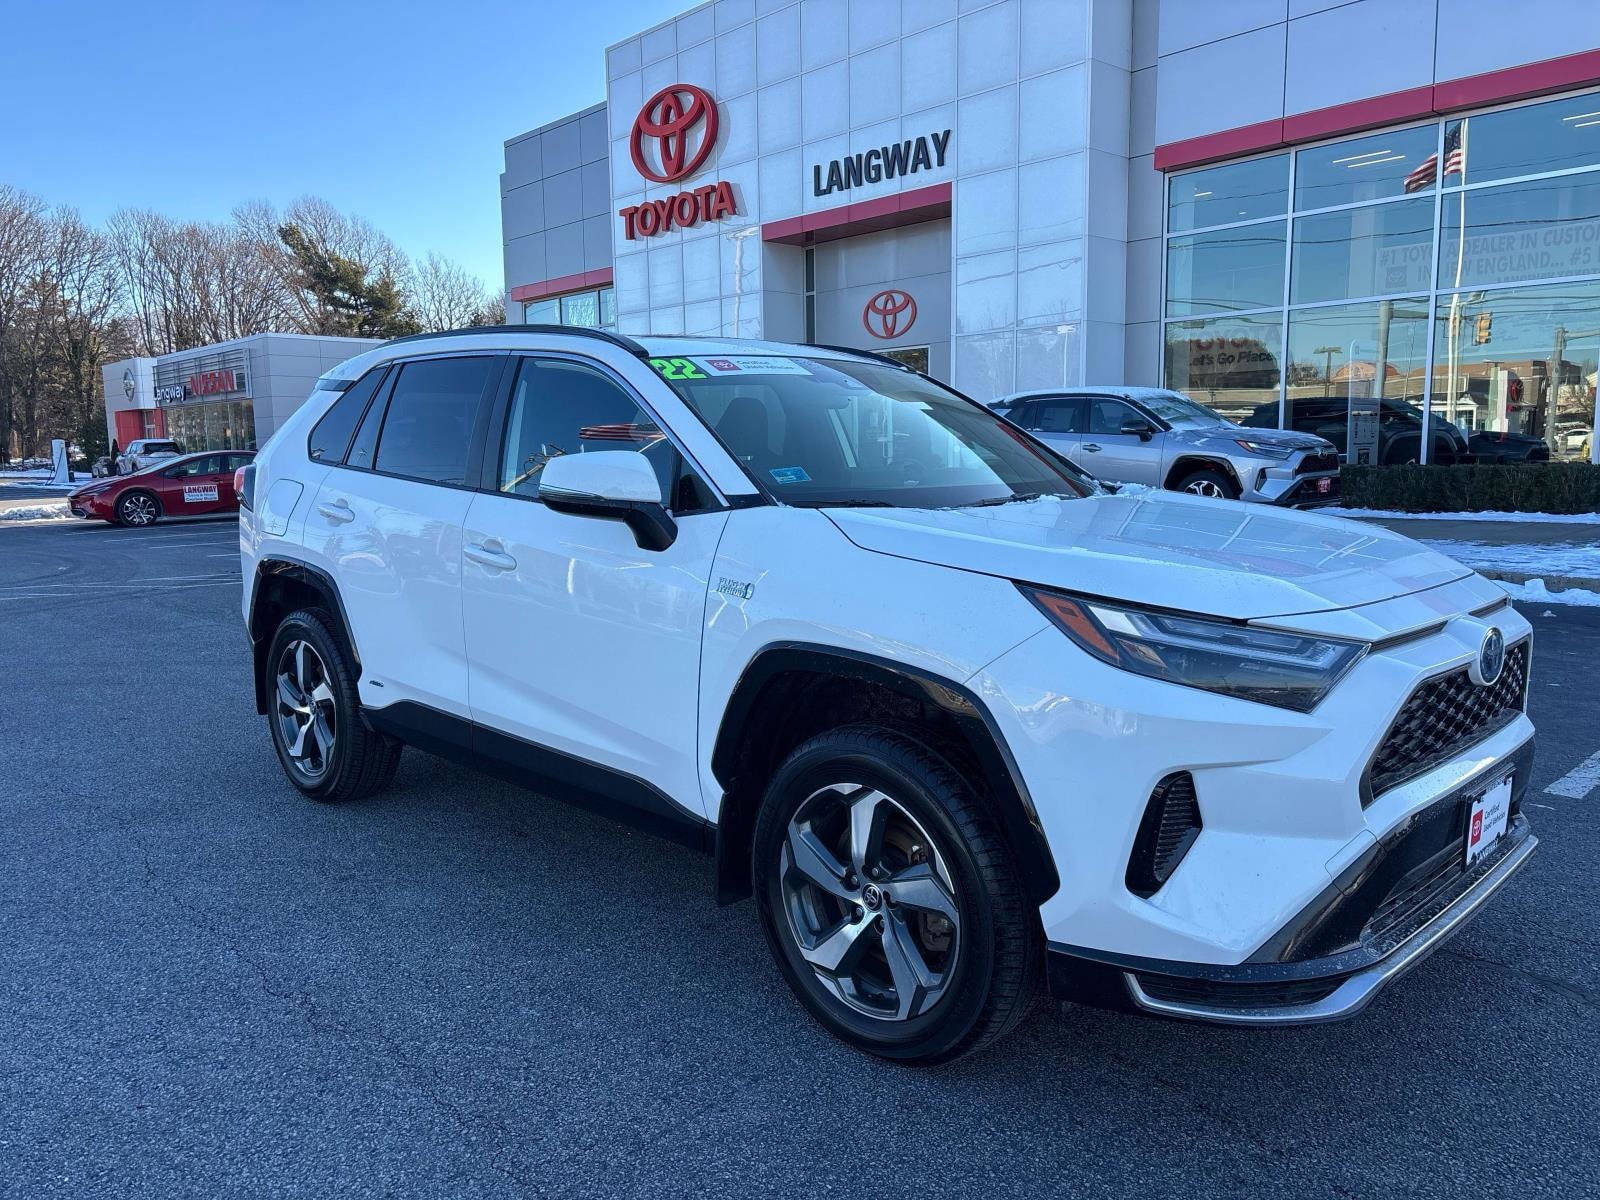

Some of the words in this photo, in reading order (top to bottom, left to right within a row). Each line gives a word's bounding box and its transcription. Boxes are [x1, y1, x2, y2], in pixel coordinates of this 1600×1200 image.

[813, 129, 951, 197] LANGWAY
[619, 181, 737, 241] TOYOTA
[1380, 248, 1396, 267] #1
[1401, 240, 1457, 263] TOYA
[1519, 231, 1539, 250] IN
[1543, 224, 1600, 247] CUSTO
[1476, 251, 1565, 275] ENGLAND...
[1569, 246, 1592, 266] #5
[649, 358, 708, 380] 22
[1190, 353, 1214, 366] et's
[1217, 352, 1235, 365] Go
[153, 385, 186, 403] Langway
[190, 369, 237, 396] NISSAN
[184, 486, 217, 494] LANGWAY
